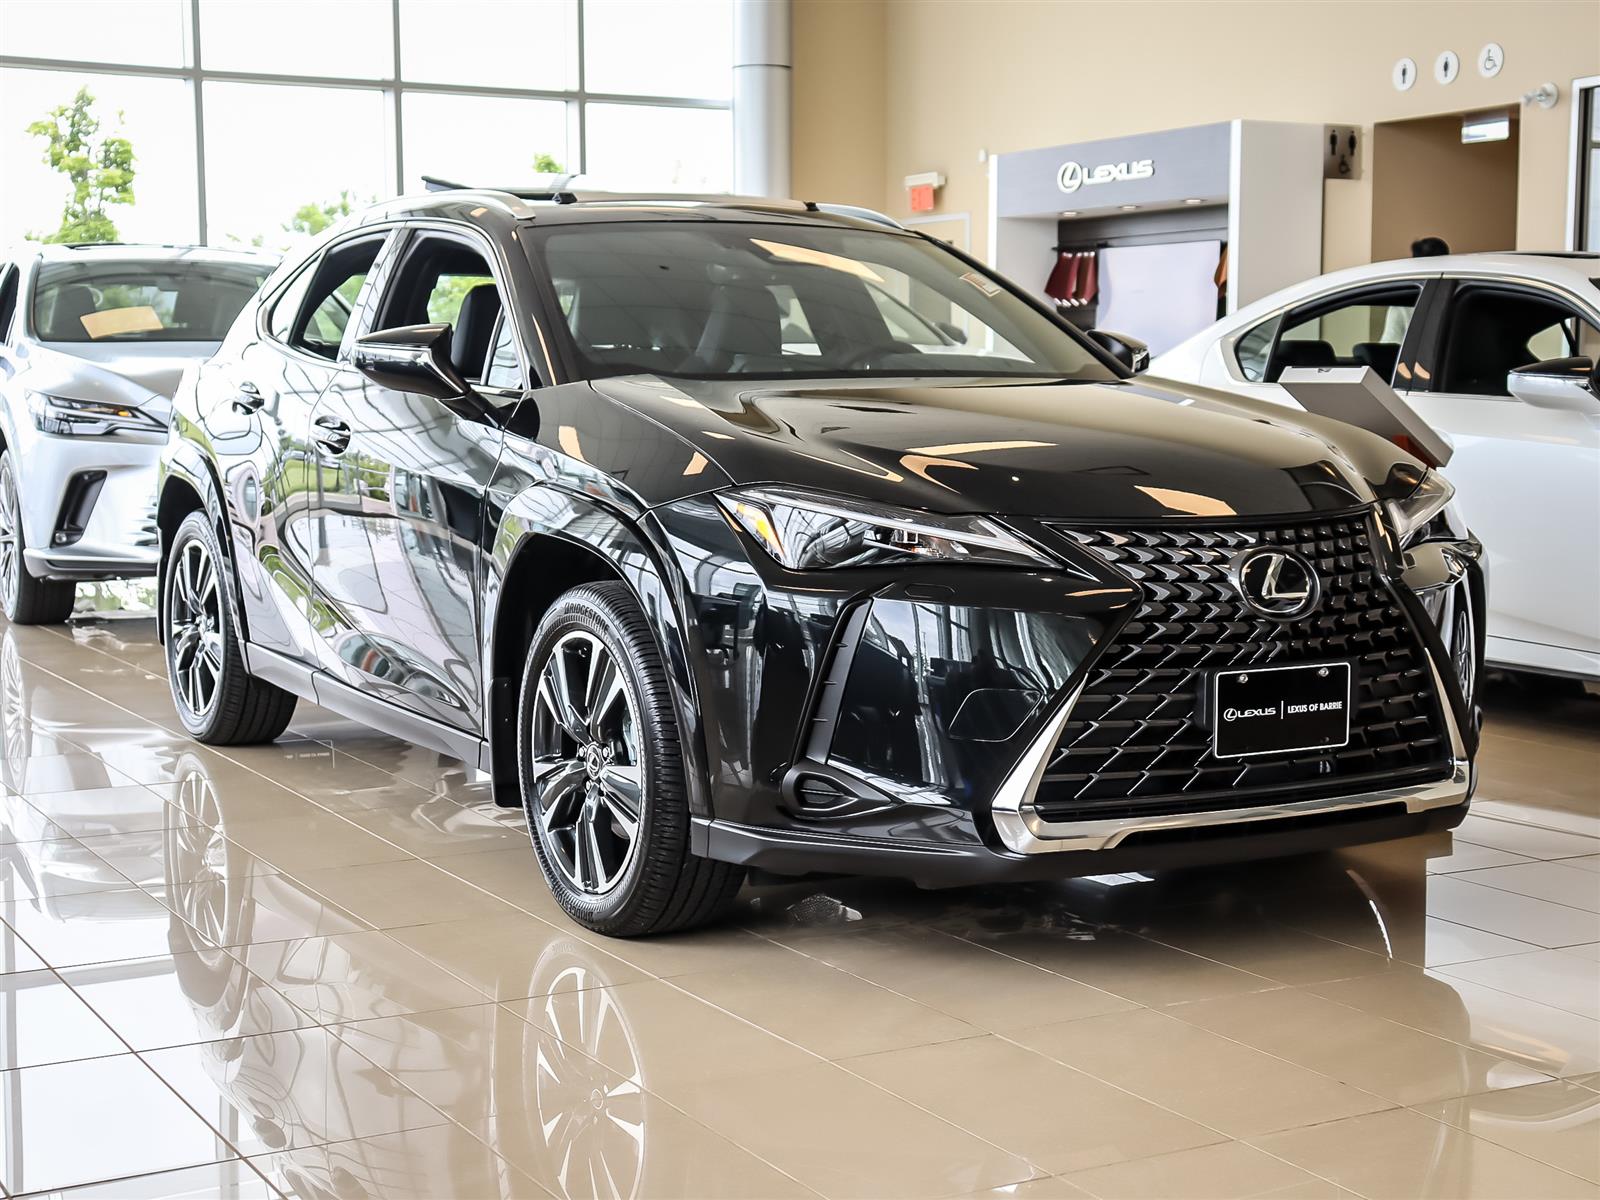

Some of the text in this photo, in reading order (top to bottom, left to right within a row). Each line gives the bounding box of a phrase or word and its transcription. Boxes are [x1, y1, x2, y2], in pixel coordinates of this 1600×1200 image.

[1082, 160, 1153, 185] LEXUS
[564, 602, 609, 632] BRIDGESTONE
[1238, 701, 1342, 718] LEXUS LEXUS OF BARRIE
